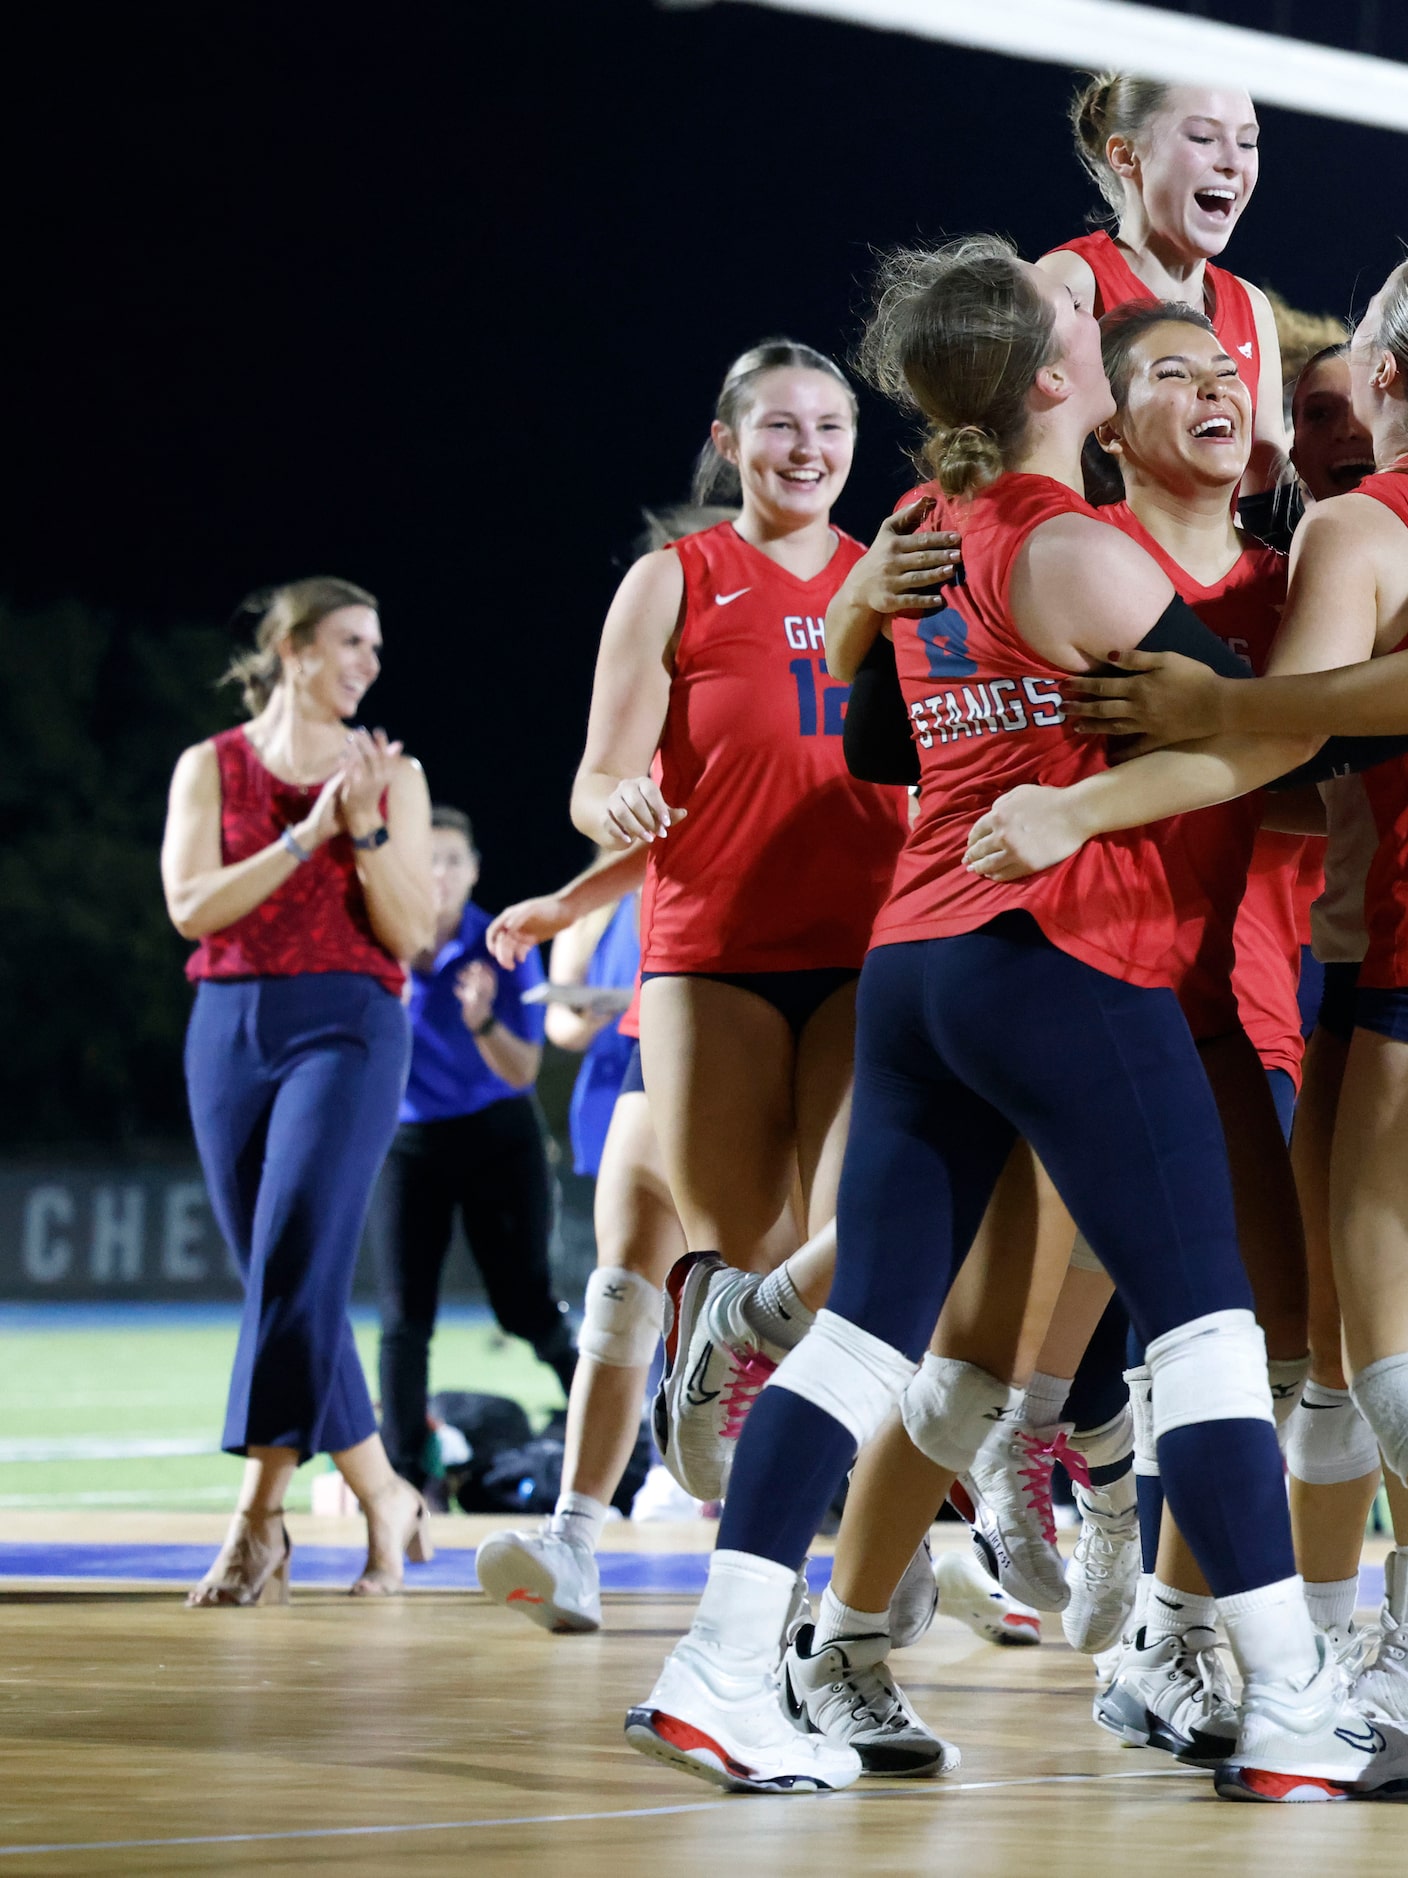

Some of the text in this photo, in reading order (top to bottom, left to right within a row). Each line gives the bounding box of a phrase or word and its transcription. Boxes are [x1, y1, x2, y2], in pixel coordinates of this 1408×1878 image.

[783, 615, 825, 650] GH
[910, 676, 1066, 749] STANGS
[24, 1182, 241, 1282] CHE
